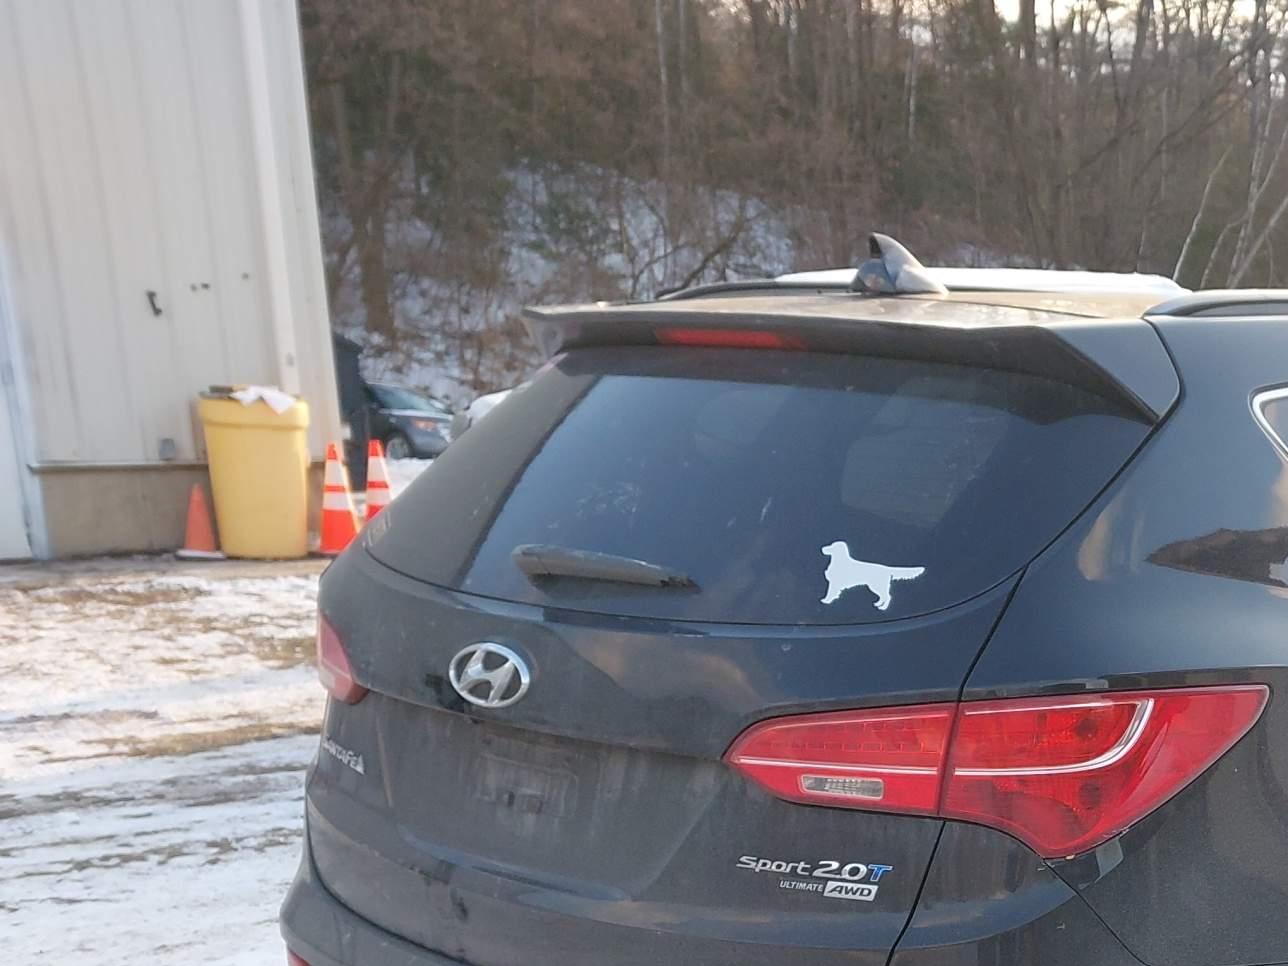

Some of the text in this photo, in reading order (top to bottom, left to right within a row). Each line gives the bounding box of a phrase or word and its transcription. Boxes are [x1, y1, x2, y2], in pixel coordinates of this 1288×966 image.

[736, 855, 811, 875] Sport
[779, 880, 873, 898] ULTIMATE AWD
